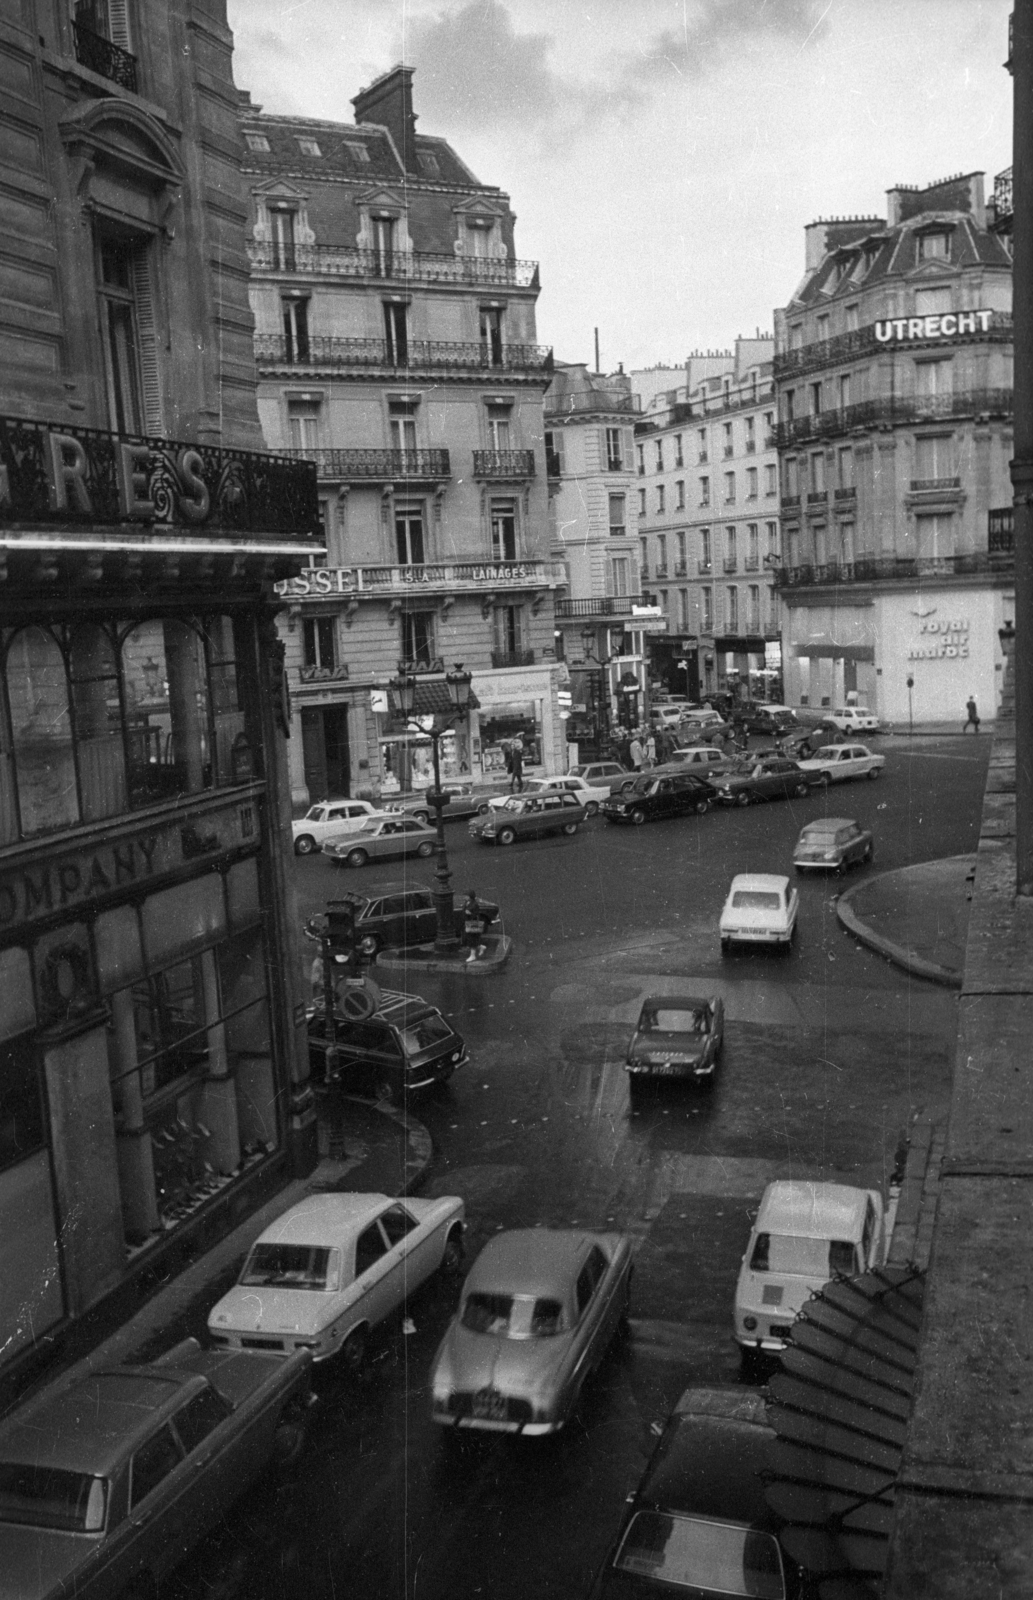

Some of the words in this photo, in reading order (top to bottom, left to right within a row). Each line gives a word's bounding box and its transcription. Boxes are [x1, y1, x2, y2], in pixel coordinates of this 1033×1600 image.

[874, 310, 993, 342] UTRECHT
[0, 431, 209, 520] RES
[473, 567, 526, 580] LAINAGES
[921, 620, 969, 636] royal
[941, 635, 969, 647] air
[908, 647, 969, 661] maroc
